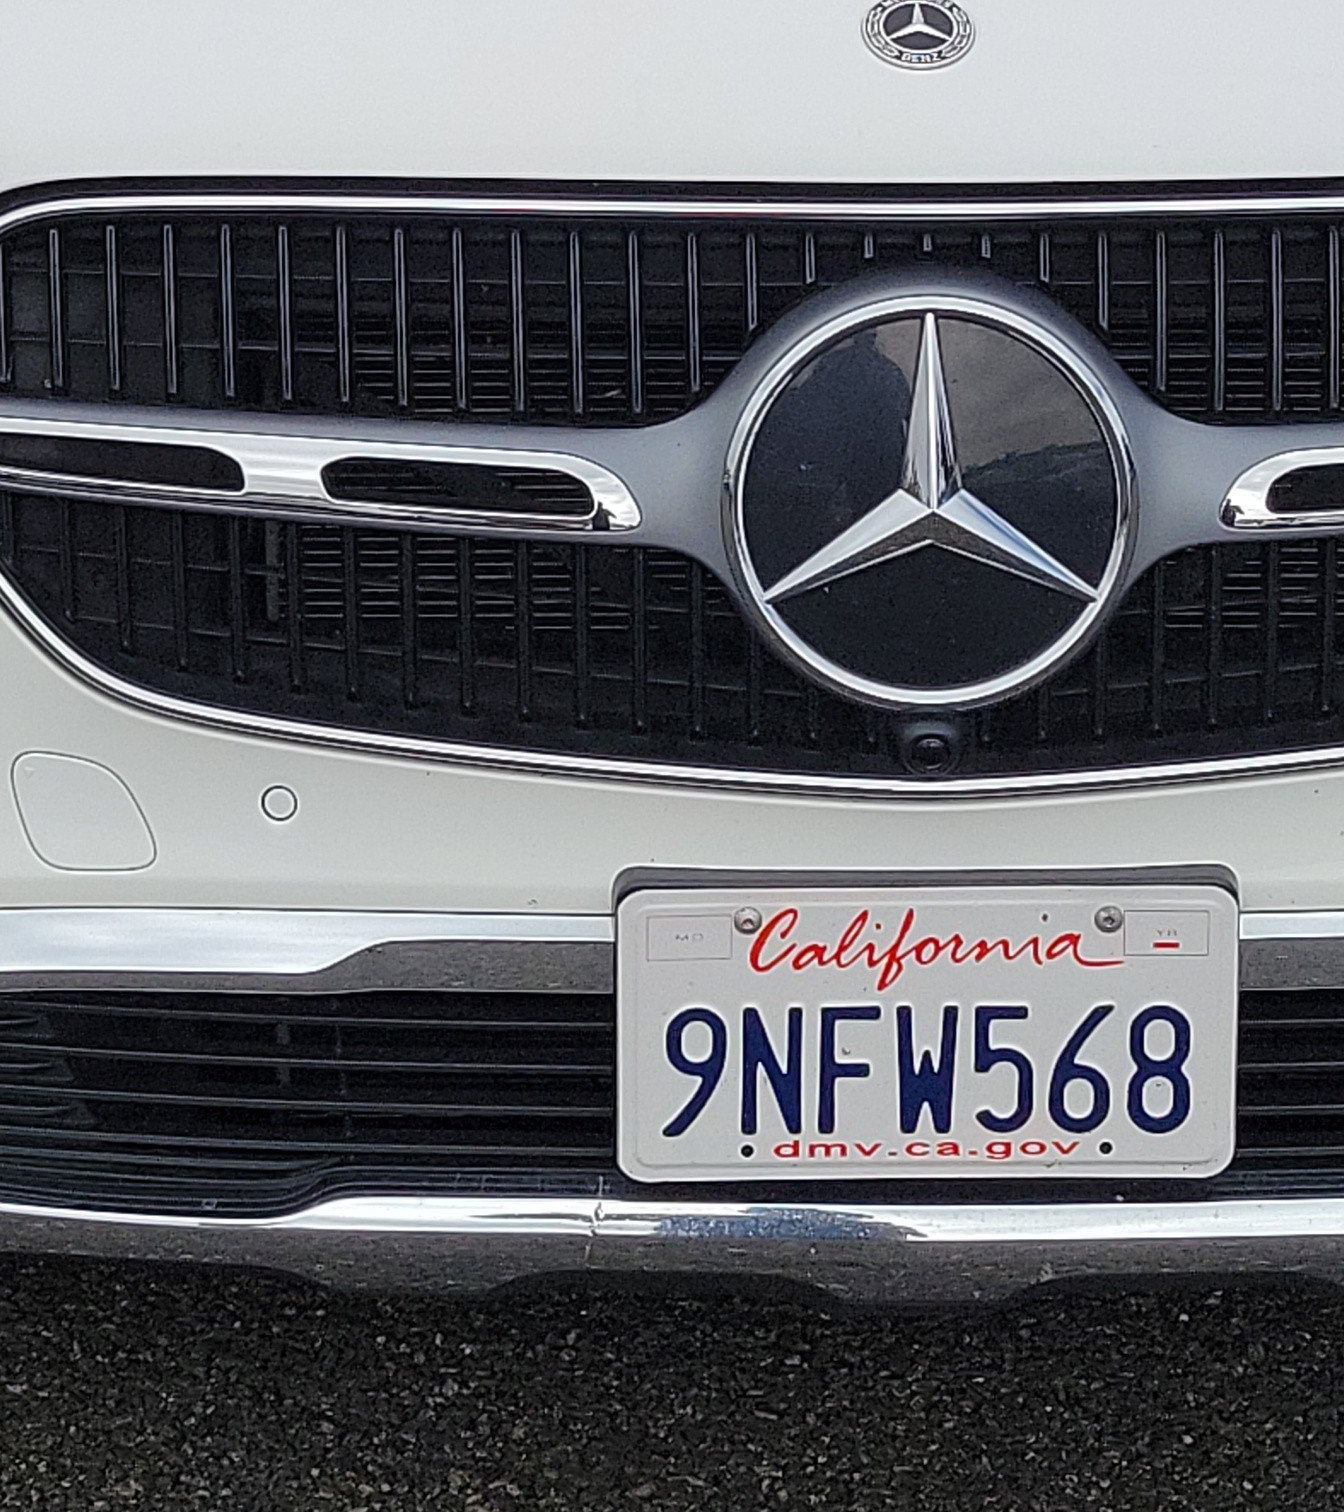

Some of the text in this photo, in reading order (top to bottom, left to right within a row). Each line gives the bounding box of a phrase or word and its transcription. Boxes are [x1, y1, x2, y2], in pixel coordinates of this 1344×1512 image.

[748, 907, 1125, 991] California
[662, 1004, 1192, 1138] 9NFW568
[773, 1138, 1081, 1159] dmv.ca.gov
